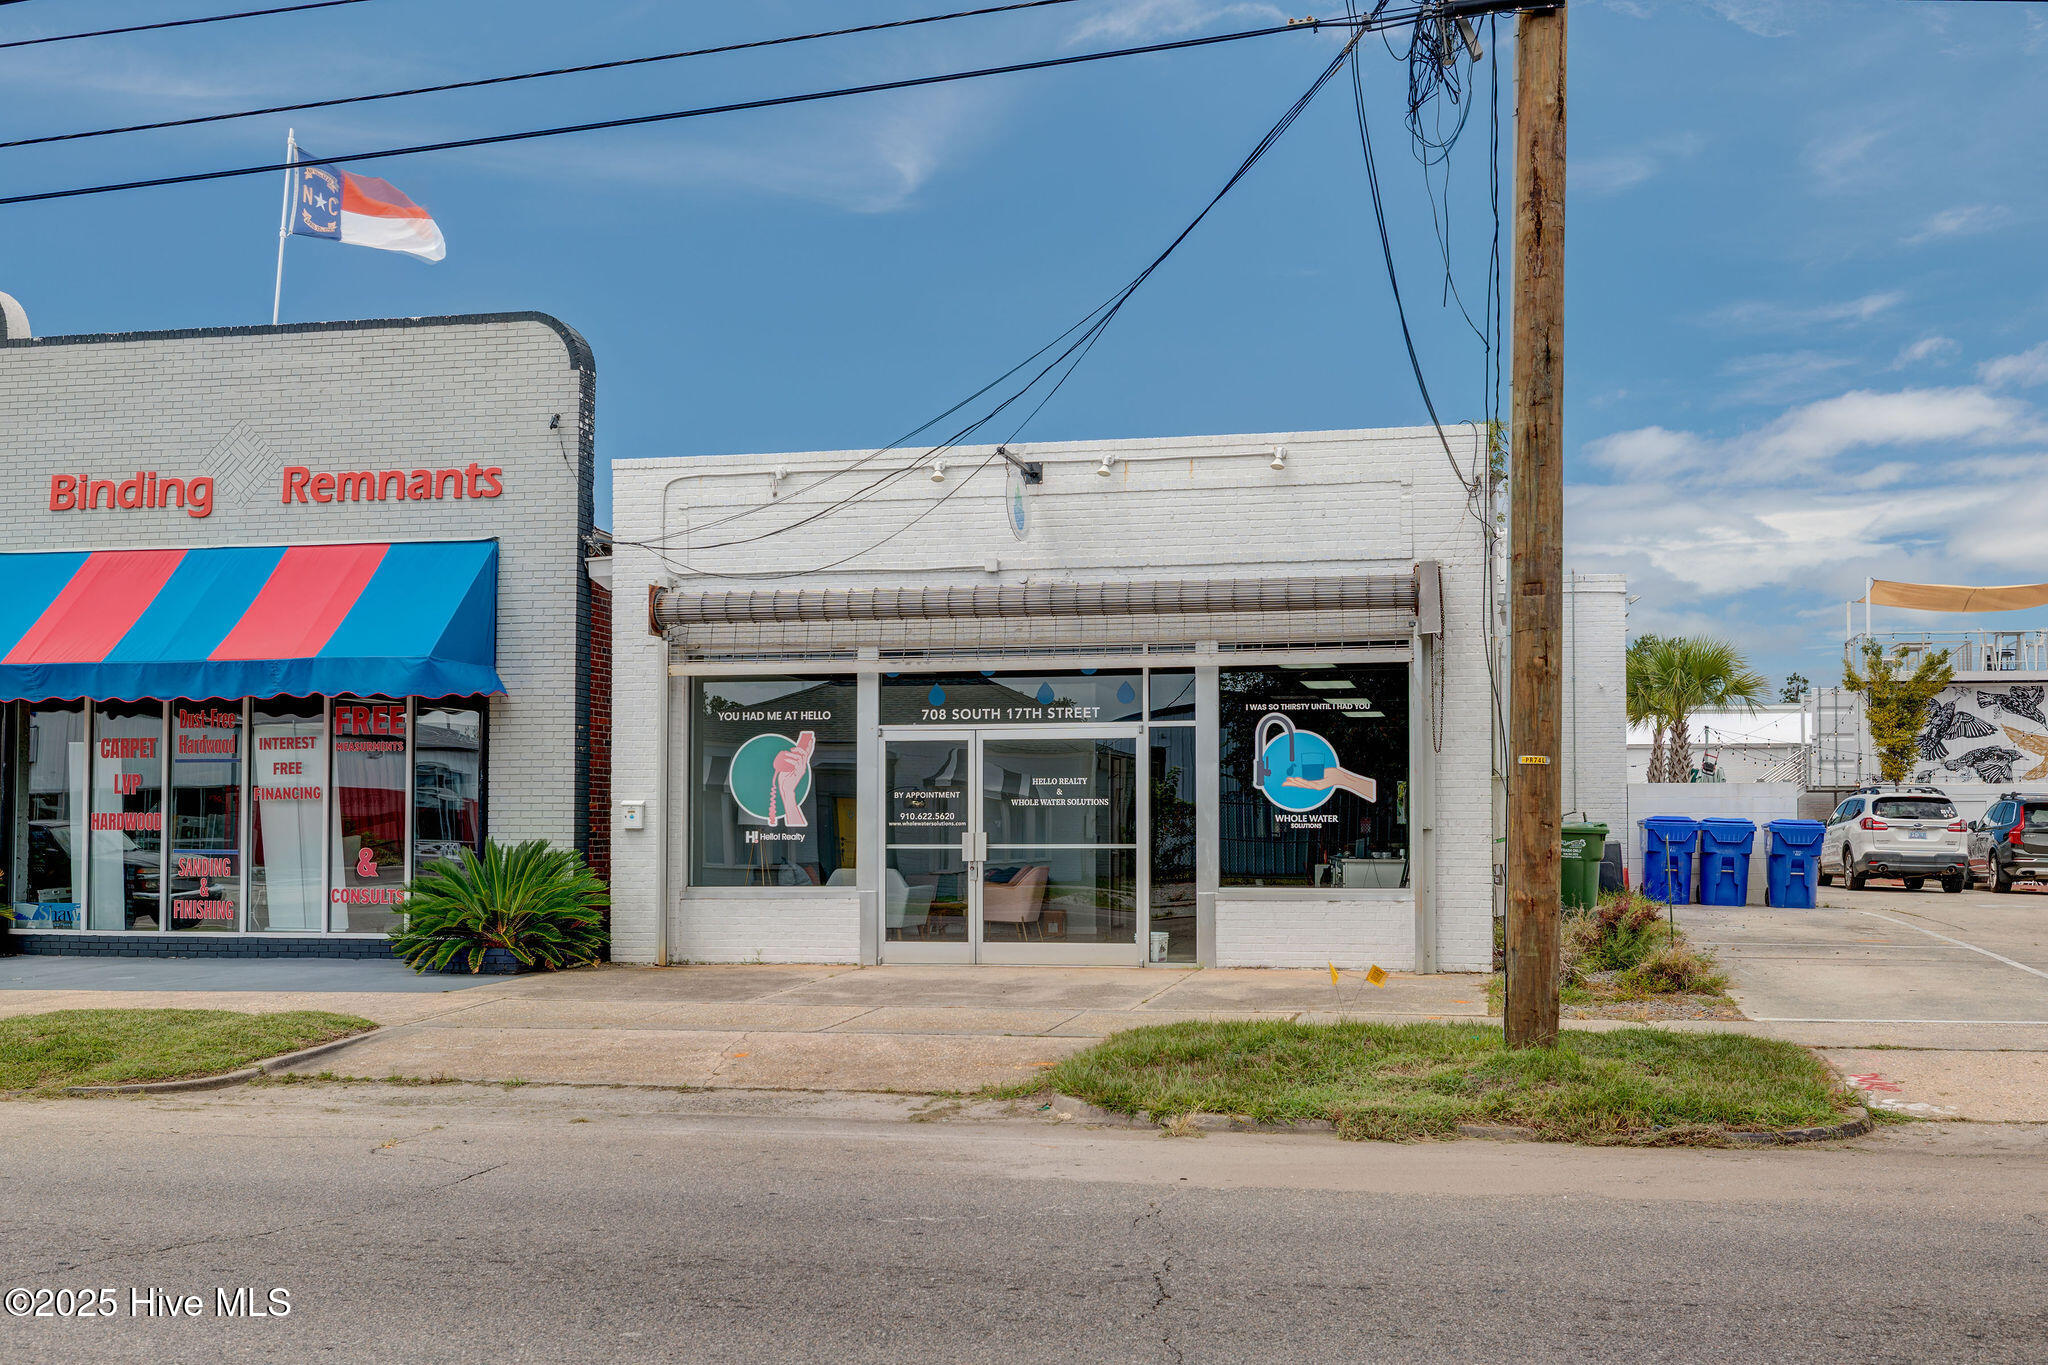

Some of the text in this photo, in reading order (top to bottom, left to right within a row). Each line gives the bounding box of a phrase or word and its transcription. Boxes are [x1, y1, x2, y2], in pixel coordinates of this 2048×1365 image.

[303, 184, 339, 216] N C
[282, 462, 503, 504] Remnants
[49, 471, 213, 518] Binding
[922, 706, 1100, 720] 708 SOUTH 17TH STREET
[1250, 703, 1267, 711] WAS
[1268, 703, 1279, 711] SO
[179, 708, 236, 729] Dust-Free
[335, 705, 405, 736] FREE
[718, 710, 831, 721] YOU HAD ME AT HELLO
[100, 737, 157, 759] CARPET
[178, 734, 236, 754] Hardwood
[259, 736, 317, 750] INTEREST
[335, 740, 405, 752] MEASURMENTS
[273, 761, 303, 775] FREE
[113, 773, 143, 796] LVP
[1032, 777, 1088, 785] HELLO REALTY
[253, 786, 321, 801] FINANCING
[894, 791, 961, 799] BY APPOINTMENT
[1056, 788, 1063, 796] &
[1066, 798, 1109, 806] SOLUTIONS
[91, 812, 162, 831] HARDWOOD
[900, 812, 955, 820] 910.622.5620
[1275, 814, 1339, 823] WHOLE WATER
[781, 833, 805, 842] Realty
[178, 857, 231, 877] SANDING
[357, 847, 379, 877] &
[200, 878, 209, 897] &
[331, 888, 405, 904] CONSULTS
[40, 905, 80, 921] Shaw
[173, 900, 234, 920] FINISHING
